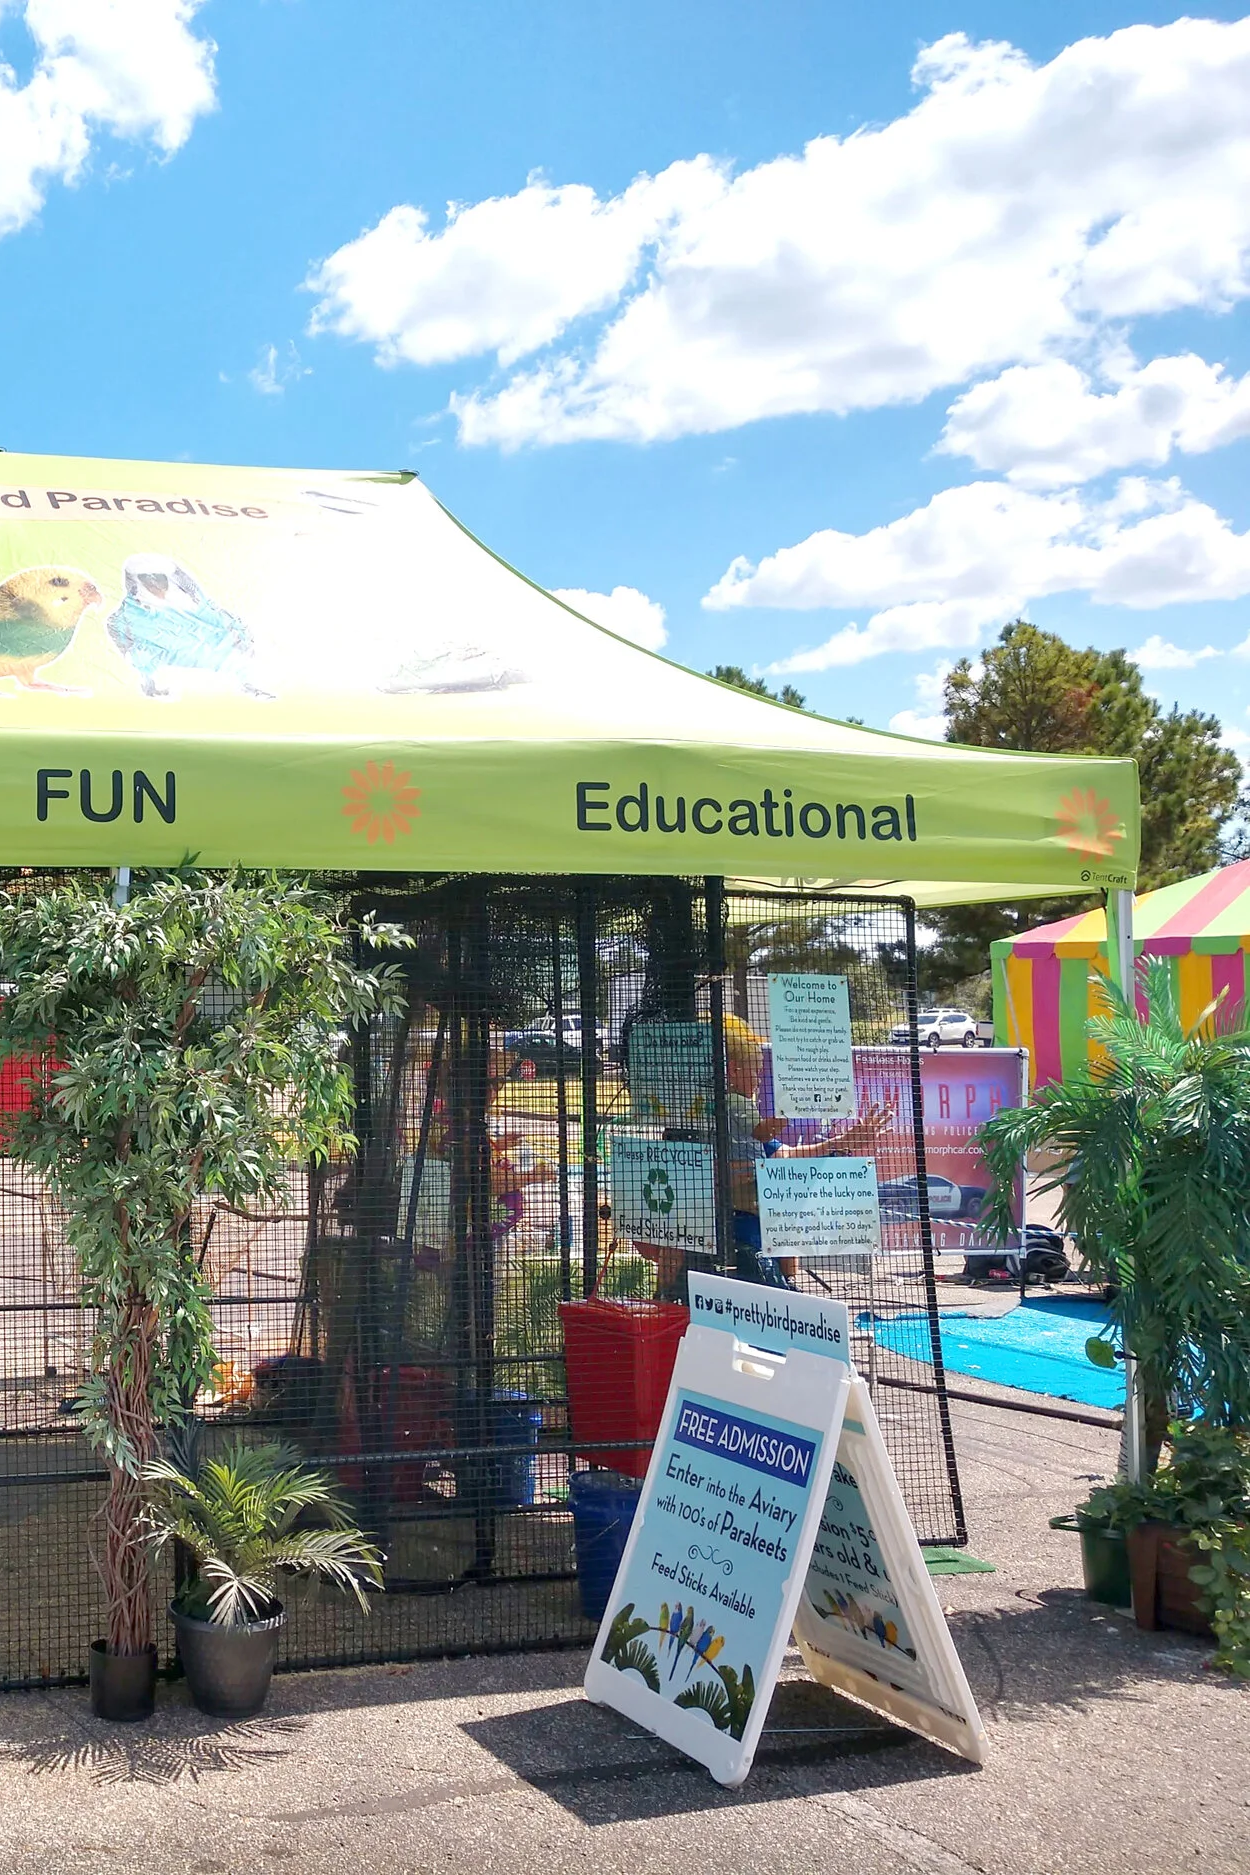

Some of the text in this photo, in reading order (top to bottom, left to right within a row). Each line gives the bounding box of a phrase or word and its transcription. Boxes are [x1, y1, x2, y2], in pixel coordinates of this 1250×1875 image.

[46, 490, 270, 520] Paradise
[36, 768, 176, 824] FUN
[576, 781, 918, 841] Educational
[1091, 872, 1127, 884] TentCraft
[781, 977, 837, 990] Welcome to
[785, 990, 835, 1004] Our Home
[897, 1055, 925, 1065] Flos
[857, 1083, 1002, 1118] AMRPH
[618, 1143, 703, 1168] Please RECYCLE
[766, 1165, 868, 1183] Will they Poop on me?
[763, 1187, 784, 1202] Only
[786, 1187, 792, 1199] if
[820, 1186, 833, 1199] the
[834, 1186, 855, 1200] lucky
[857, 1189, 874, 1197] one.
[768, 1208, 780, 1218] The
[782, 1208, 797, 1218] story
[831, 1206, 843, 1216] bird
[845, 1209, 863, 1218] poops
[619, 1214, 705, 1246] Feed Sticks Here
[766, 1225, 777, 1234] you
[779, 1223, 784, 1231] it
[784, 1223, 804, 1234] brings
[805, 1221, 820, 1233] good
[821, 1221, 834, 1231] luck
[835, 1221, 844, 1230] for
[846, 1222, 856, 1230] 30
[772, 1237, 800, 1247] Sanitizer
[801, 1236, 828, 1246] available
[838, 1235, 854, 1245] front
[725, 1299, 841, 1343] #prettybirdparadise
[679, 1409, 810, 1477] FREE ADMISSION
[666, 1453, 798, 1533] Enter into the Aviary
[657, 1494, 788, 1563] with 100's of Parakeets
[837, 1542, 861, 1570] old
[863, 1552, 881, 1578] &
[651, 1552, 756, 1619] Feed Sticks Available
